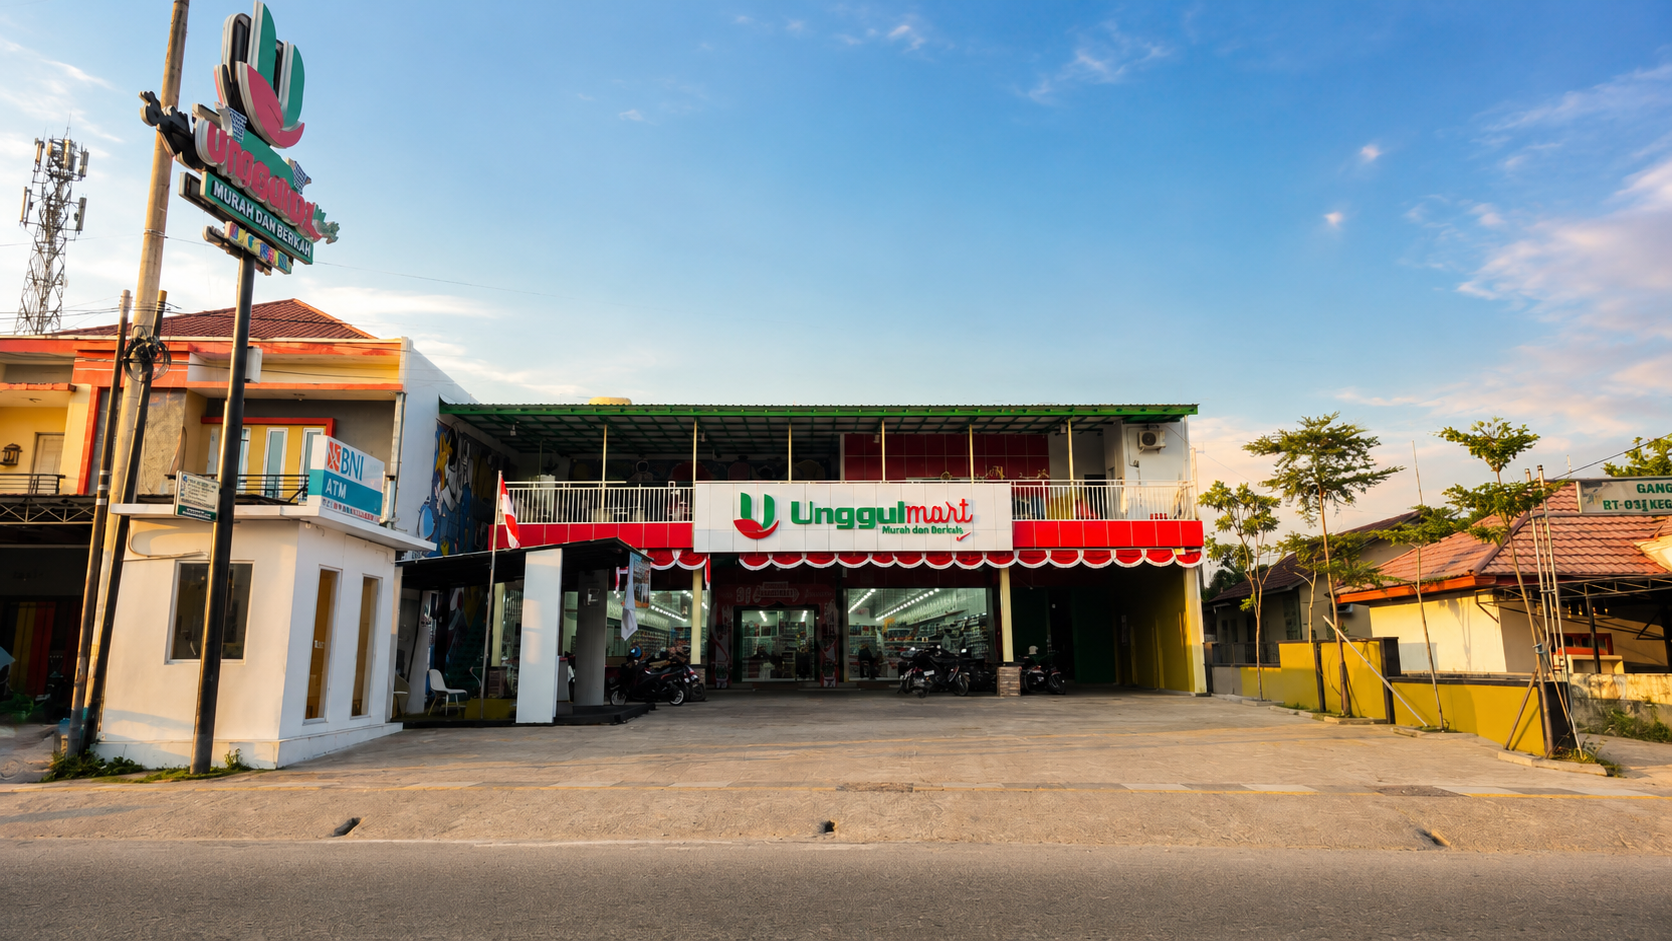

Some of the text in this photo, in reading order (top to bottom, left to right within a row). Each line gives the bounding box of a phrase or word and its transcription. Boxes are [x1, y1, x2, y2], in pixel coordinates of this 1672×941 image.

[213, 180, 254, 221] MURAH
[276, 225, 311, 258] BERKAH
[341, 446, 364, 481] BNI
[325, 478, 347, 499] ATM
[1636, 483, 1672, 494] GANG
[882, 525, 910, 535] Murah
[912, 525, 929, 534] dan
